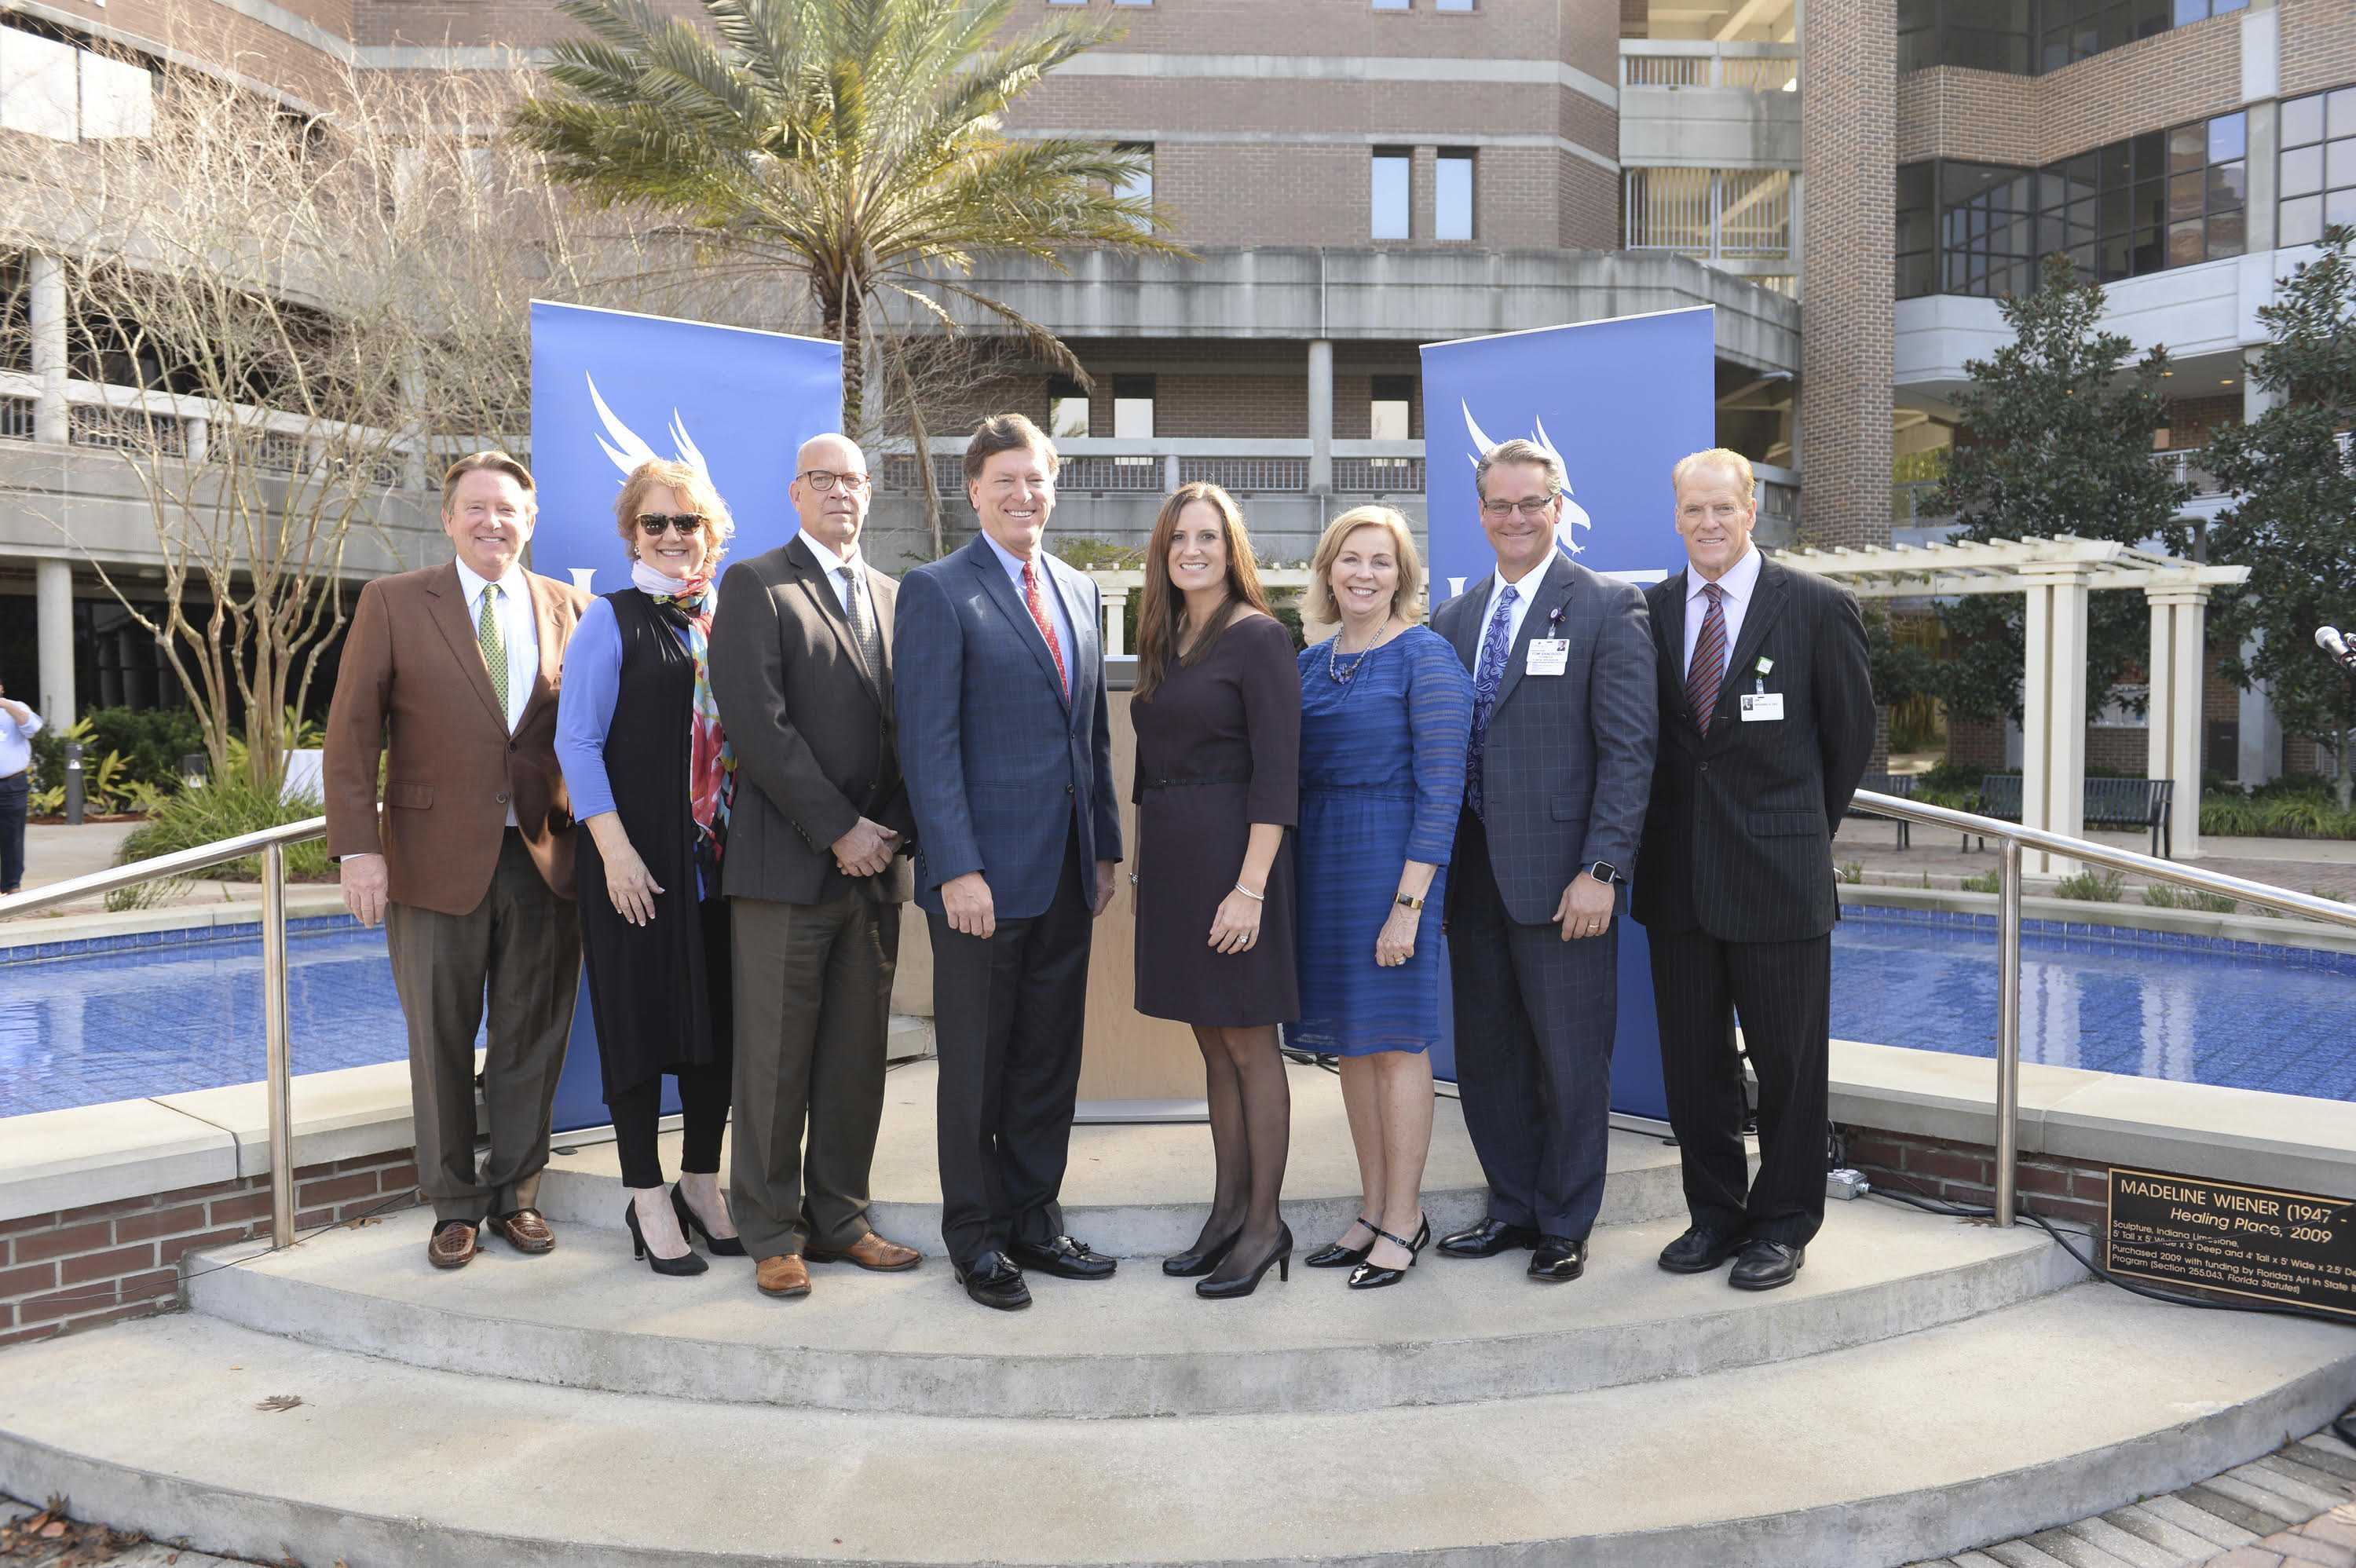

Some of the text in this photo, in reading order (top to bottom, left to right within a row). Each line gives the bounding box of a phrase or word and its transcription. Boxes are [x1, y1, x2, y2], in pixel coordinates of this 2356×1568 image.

[2120, 1179, 2206, 1205] MADELINE
[2213, 1193, 2280, 1216] WIENER
[2287, 1204, 2332, 1223] (1947
[2113, 1219, 2153, 1234] Sculpture,
[2157, 1227, 2190, 1239] Indiana
[2170, 1208, 2332, 1244] Healing Place, 2009
[2112, 1244, 2157, 1258] Purchased
[2160, 1252, 2182, 1262] 2009
[2185, 1257, 2202, 1266] with
[2205, 1260, 2239, 1274] funding
[2242, 1266, 2254, 1276] by
[2256, 1268, 2293, 1282] Florida's
[2296, 1275, 2310, 1285] Art
[2325, 1279, 2349, 1291] State
[2123, 1230, 2135, 1241] Tall
[2197, 1243, 2222, 1255] Deep
[2225, 1249, 2244, 1258] and
[2255, 1253, 2270, 1263] Tall
[2281, 1257, 2288, 1266] 5'
[2291, 1259, 2315, 1270] Wide
[2112, 1254, 2300, 1295] Program (Section 255.043, Florida Statutes)
